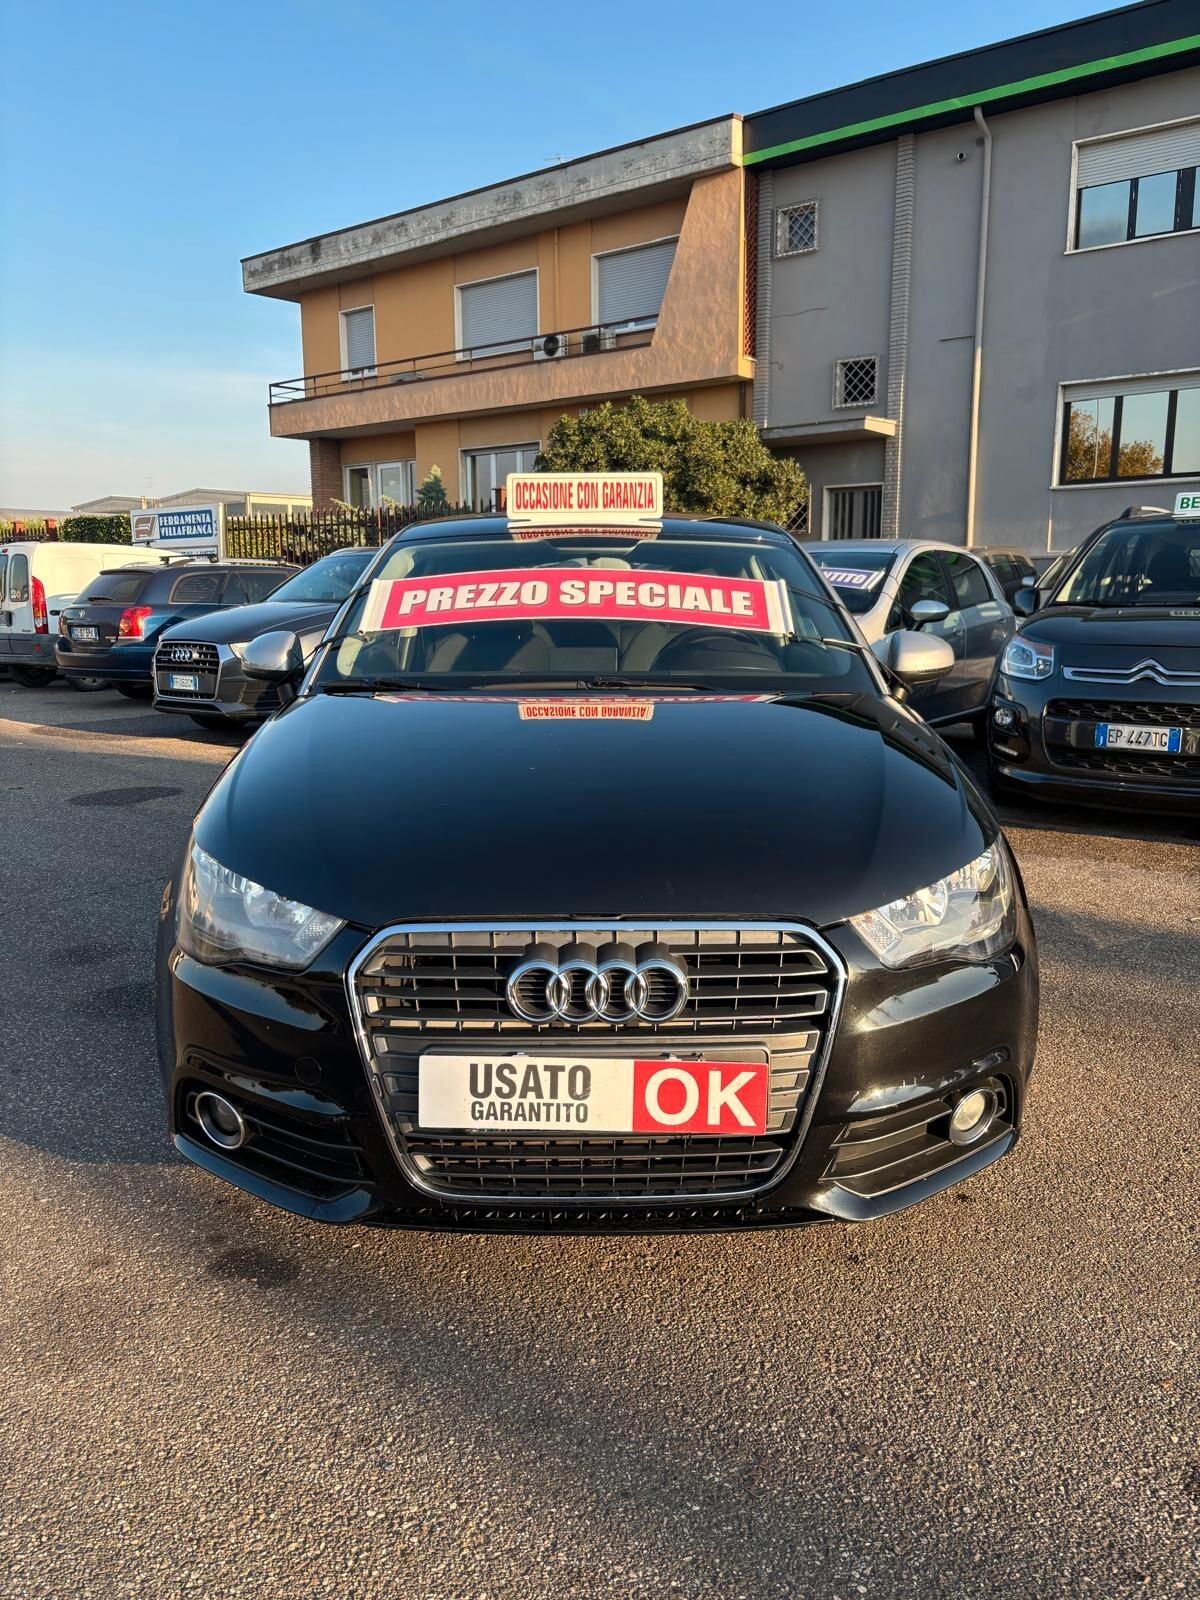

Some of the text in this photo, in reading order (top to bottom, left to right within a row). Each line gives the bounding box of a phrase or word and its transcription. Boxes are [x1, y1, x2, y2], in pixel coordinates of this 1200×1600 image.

[515, 482, 654, 510] OCCASIONE CON GARANZIA
[159, 513, 211, 527] FERRAMENTA
[160, 524, 212, 537] VILLAFRANCA
[398, 580, 755, 617] PREZZO SPECIALE
[469, 1062, 592, 1101] USATO
[644, 1067, 757, 1128] OK
[471, 1101, 589, 1124] GARANTITO
